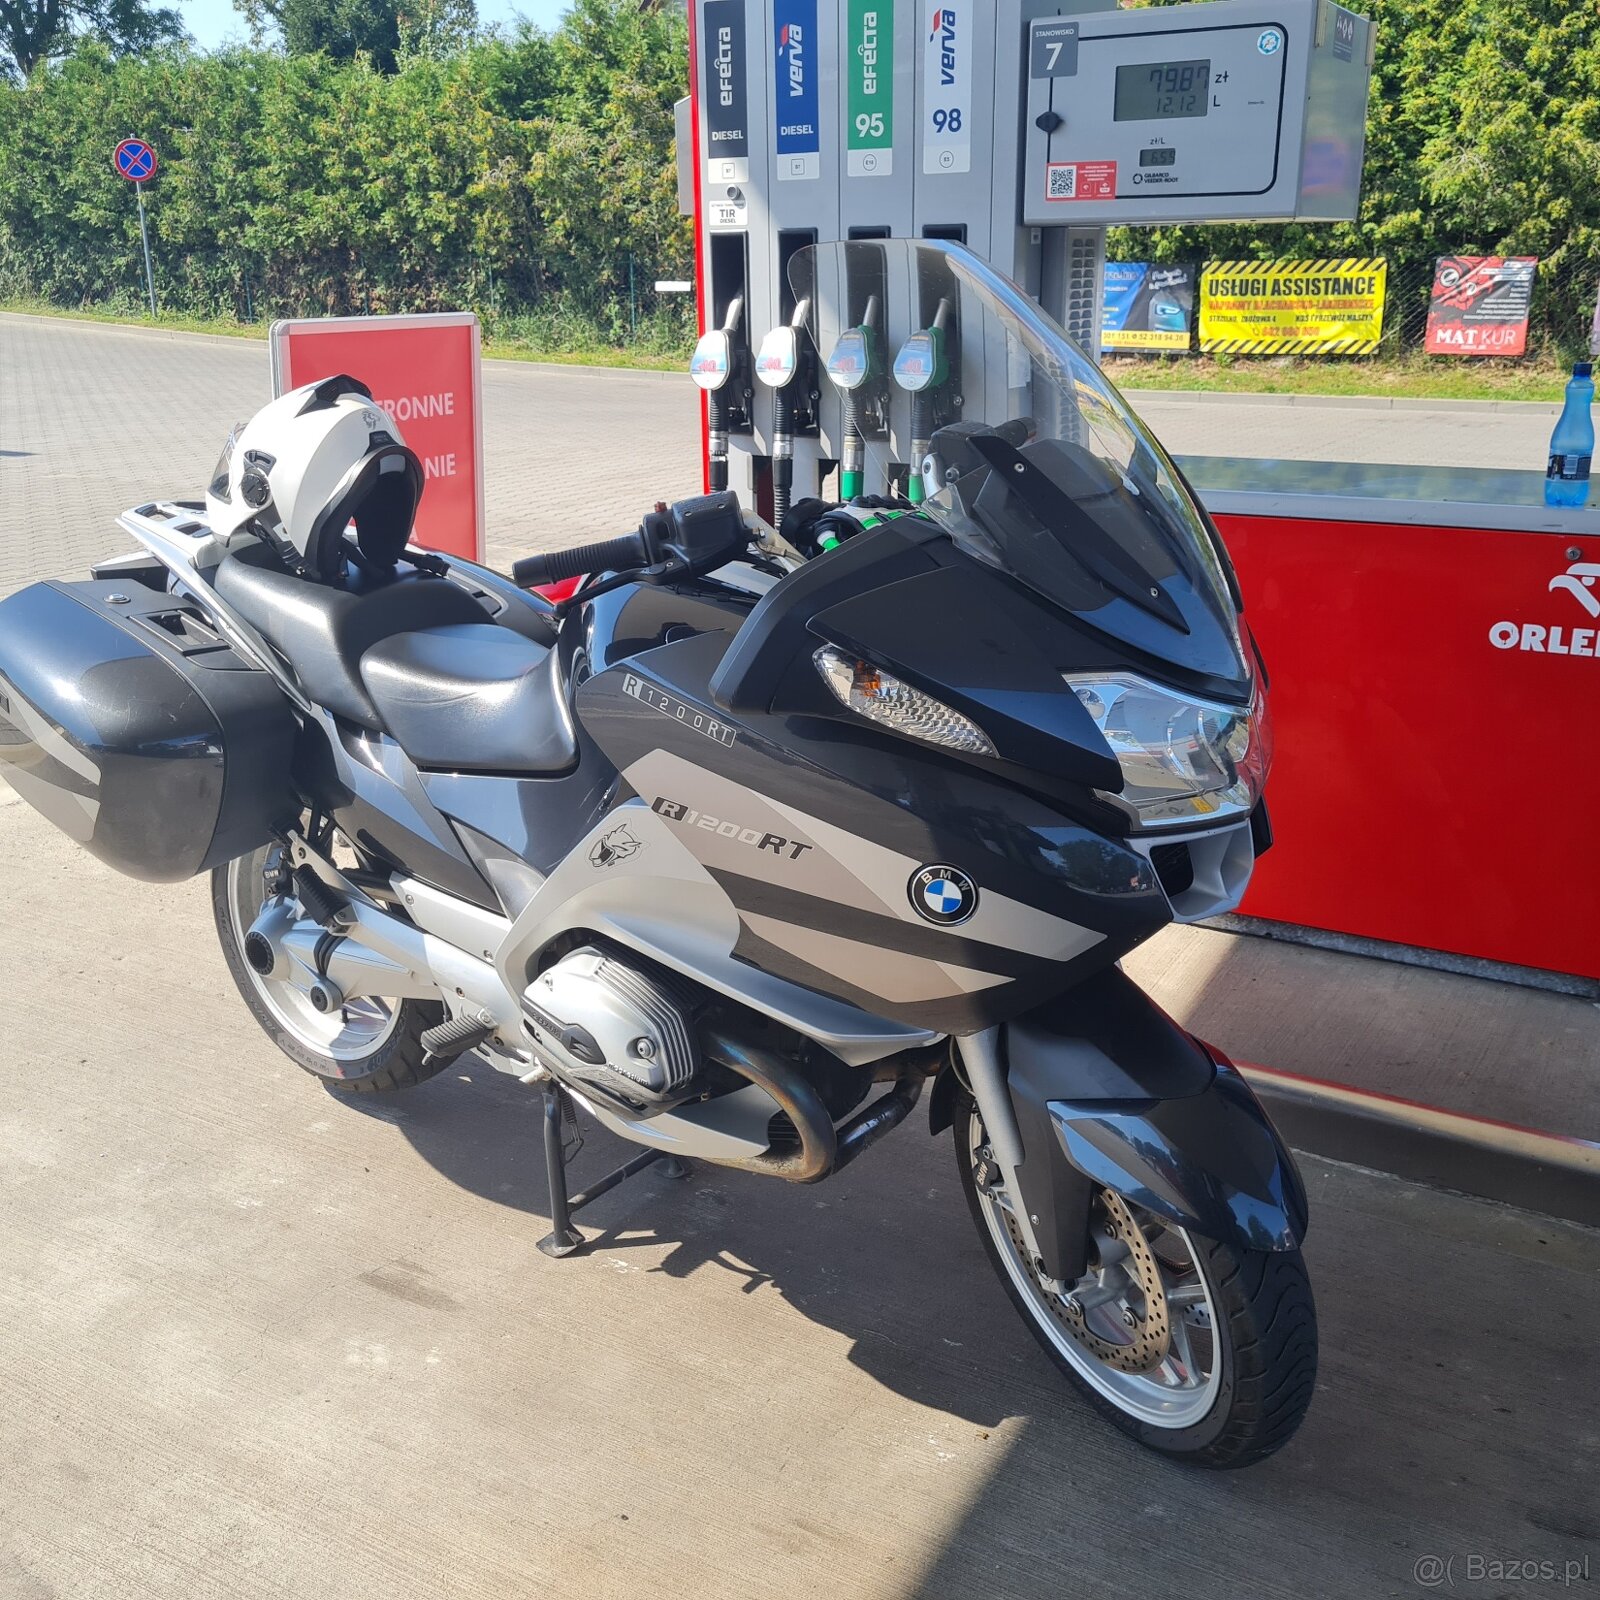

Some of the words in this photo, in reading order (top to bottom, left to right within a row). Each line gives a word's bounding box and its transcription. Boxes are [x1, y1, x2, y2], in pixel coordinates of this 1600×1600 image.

[1035, 28, 1075, 38] STANOWISKO
[1045, 42, 1063, 70] 7
[1215, 70, 1229, 84] zł
[1213, 94, 1221, 107] L
[855, 113, 884, 138] 95
[932, 108, 962, 133] 98
[711, 129, 744, 141] DIESEL
[780, 124, 814, 136] DIESEL
[719, 209, 736, 218] TIR
[1209, 278, 1267, 297] USŁUGI
[1270, 276, 1376, 296] ASSISTANCE
[1435, 328, 1478, 344] MAT
[1480, 329, 1516, 345] KUR
[1488, 621, 1600, 658] ORLE
[920, 868, 971, 892] BMW
